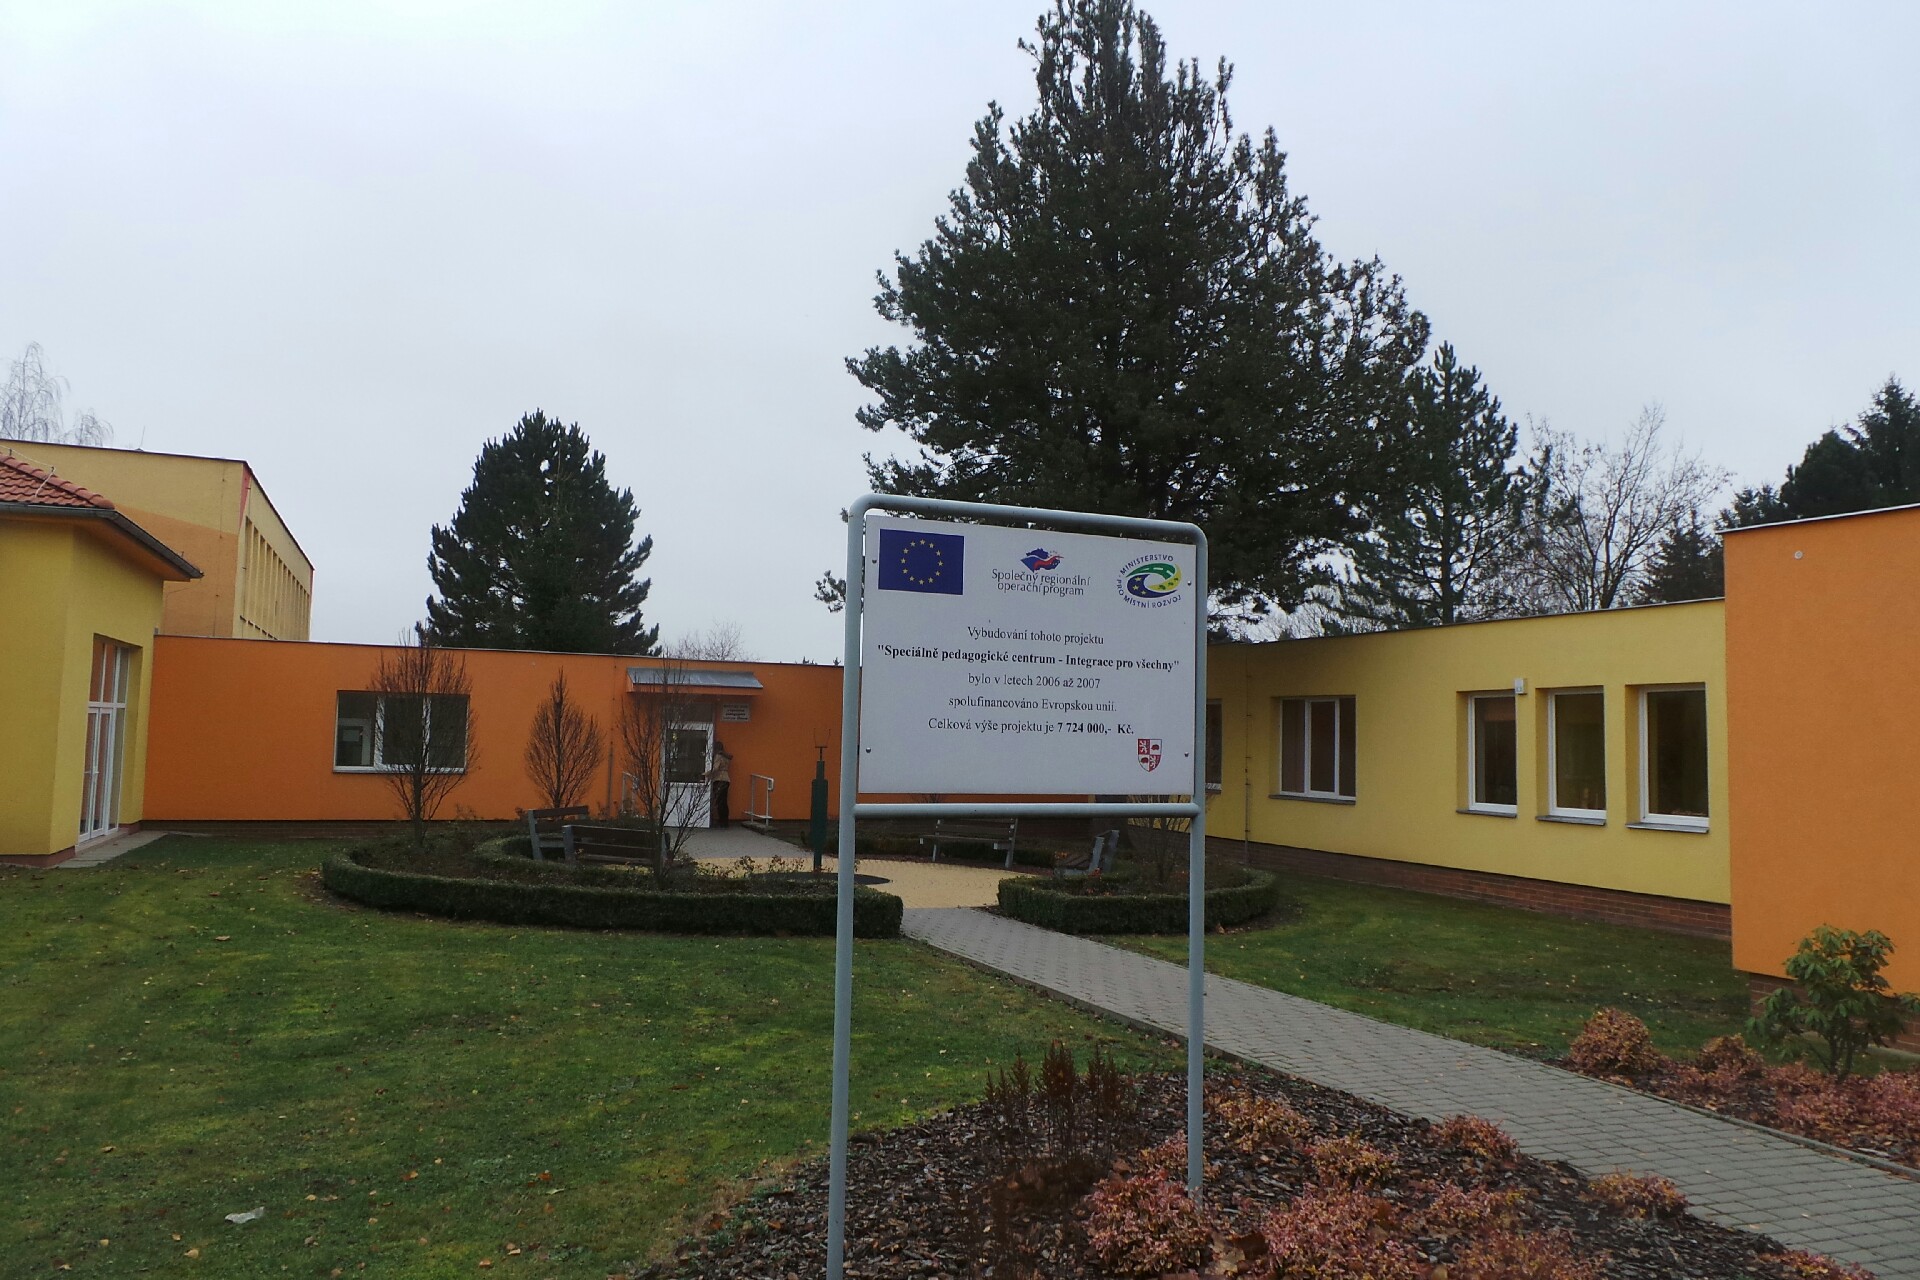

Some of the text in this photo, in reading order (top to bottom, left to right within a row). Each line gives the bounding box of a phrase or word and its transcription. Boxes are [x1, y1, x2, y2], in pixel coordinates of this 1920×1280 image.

[1120, 554, 1173, 575] MINISTERSTVO
[992, 569, 1091, 586] Společný regionální
[997, 582, 1083, 597] operační program
[1117, 579, 1125, 596] PRO
[1152, 595, 1181, 608] ROZVOJ
[968, 626, 1104, 646] Vybudování tohoto projektu
[878, 645, 939, 661] "Speciálně
[941, 650, 1009, 664] pedagogické
[1011, 653, 1056, 665] centrum
[1066, 654, 1114, 670] Integrace
[1116, 660, 1133, 671] pro
[1136, 660, 1179, 672] všechny"
[968, 673, 991, 686] bylo
[1003, 674, 1033, 686] letech
[1036, 676, 1060, 687] 2006
[1063, 677, 1074, 688] až
[1077, 678, 1100, 689] 2007
[949, 696, 1038, 710] spolufinancováno
[1042, 699, 1093, 713] Evropskou
[928, 718, 1134, 735] Celková výše projektu je 7 724 000,- Kč.
